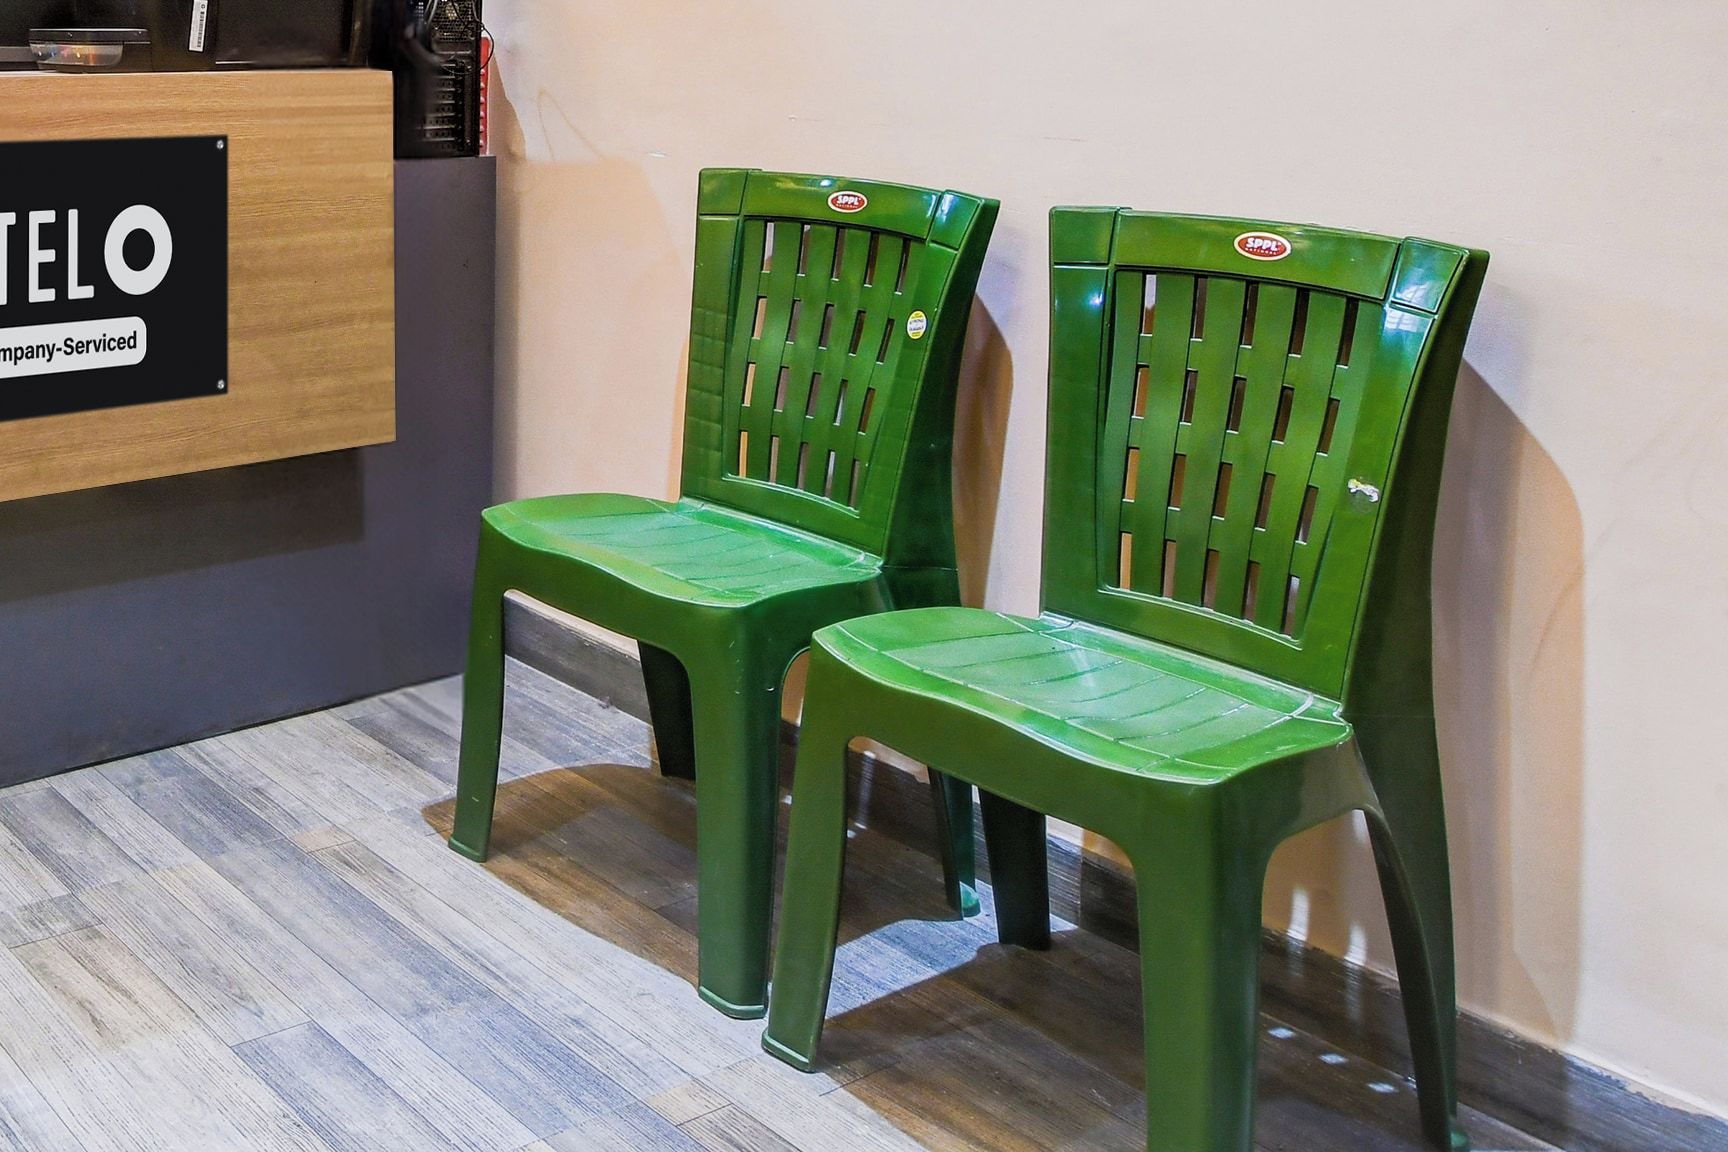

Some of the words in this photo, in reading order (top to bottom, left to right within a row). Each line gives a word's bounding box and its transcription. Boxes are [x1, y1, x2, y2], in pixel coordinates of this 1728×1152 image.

[836, 195, 860, 206] SPPL
[103, 203, 174, 296] O
[1245, 237, 1278, 252] SPPL
